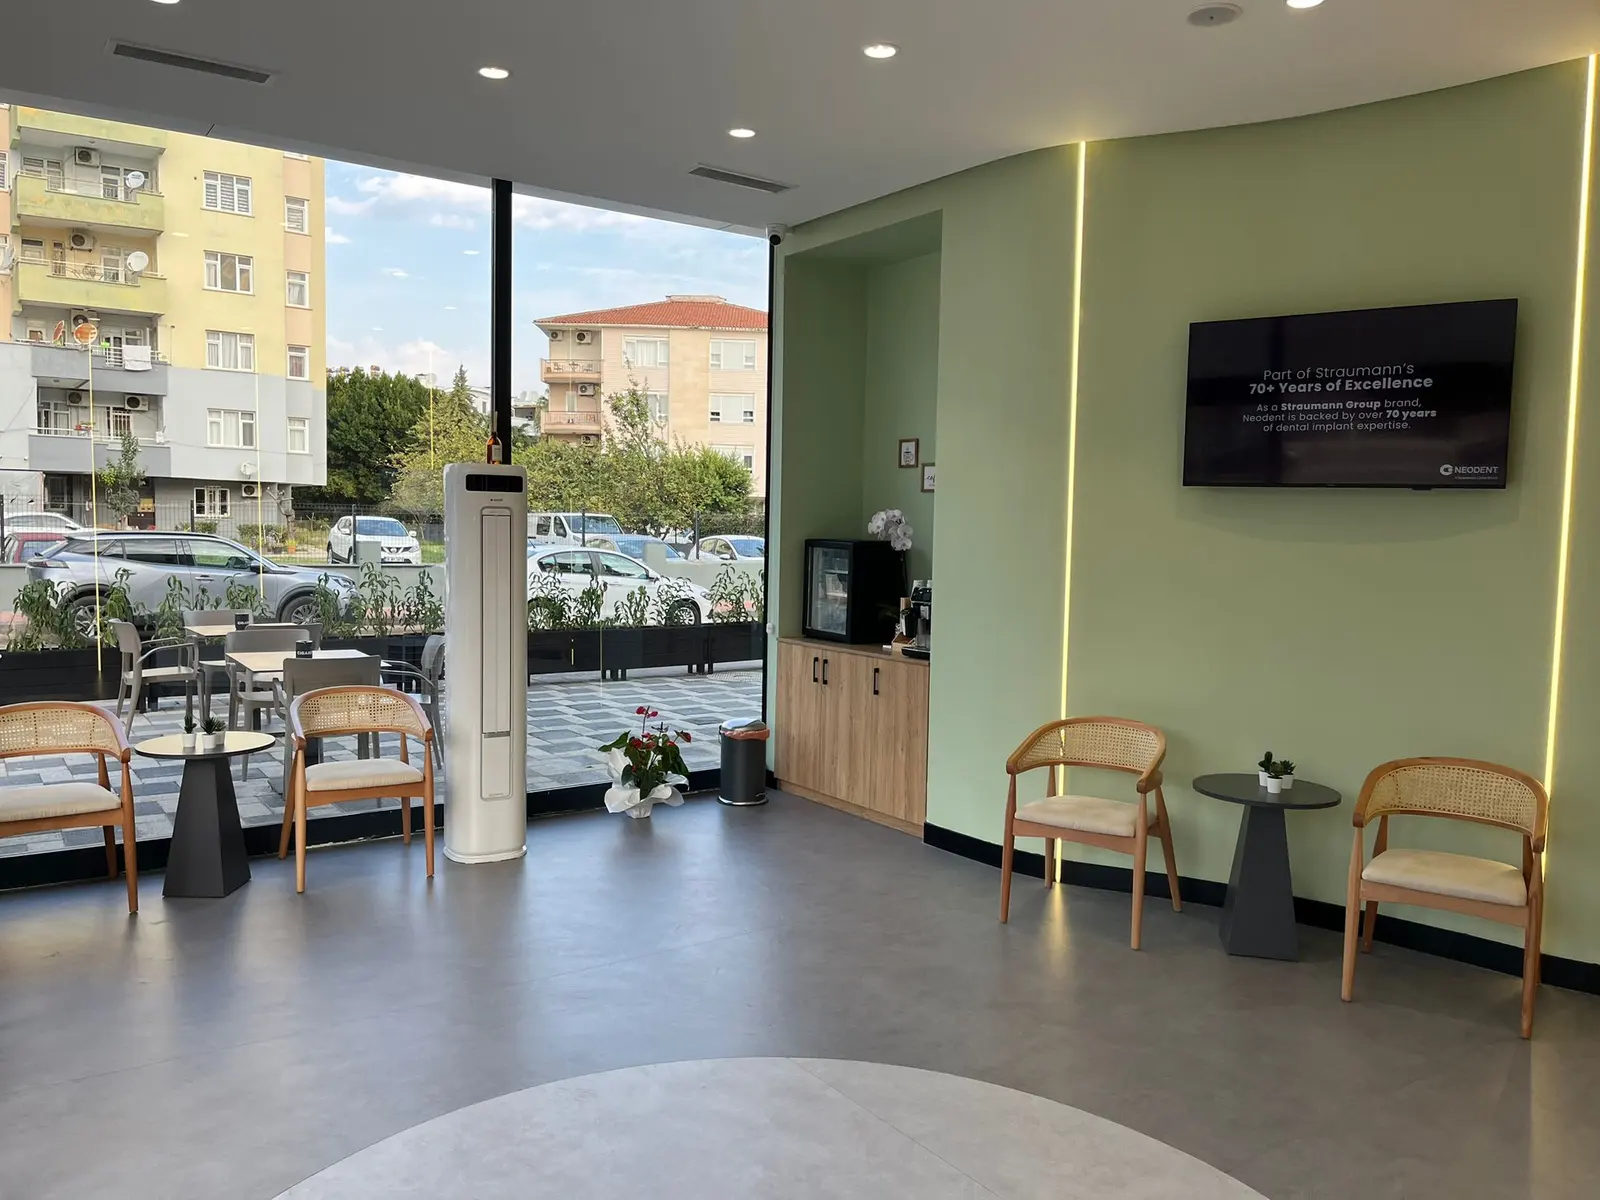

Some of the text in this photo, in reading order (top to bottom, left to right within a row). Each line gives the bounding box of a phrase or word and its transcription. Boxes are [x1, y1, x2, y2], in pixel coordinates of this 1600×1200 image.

[1263, 363, 1415, 381] Part of Straumann's
[1249, 377, 1433, 395] 70+ Years of Excellence
[1256, 403, 1269, 412] As
[1281, 401, 1343, 411] Straumann
[1346, 400, 1381, 411] Group
[1384, 398, 1422, 408] brand,
[1243, 409, 1437, 422] Neodent is backed by over 70 years
[1263, 421, 1411, 433] of dental implant expertise.
[1454, 466, 1499, 474] NEODENT
